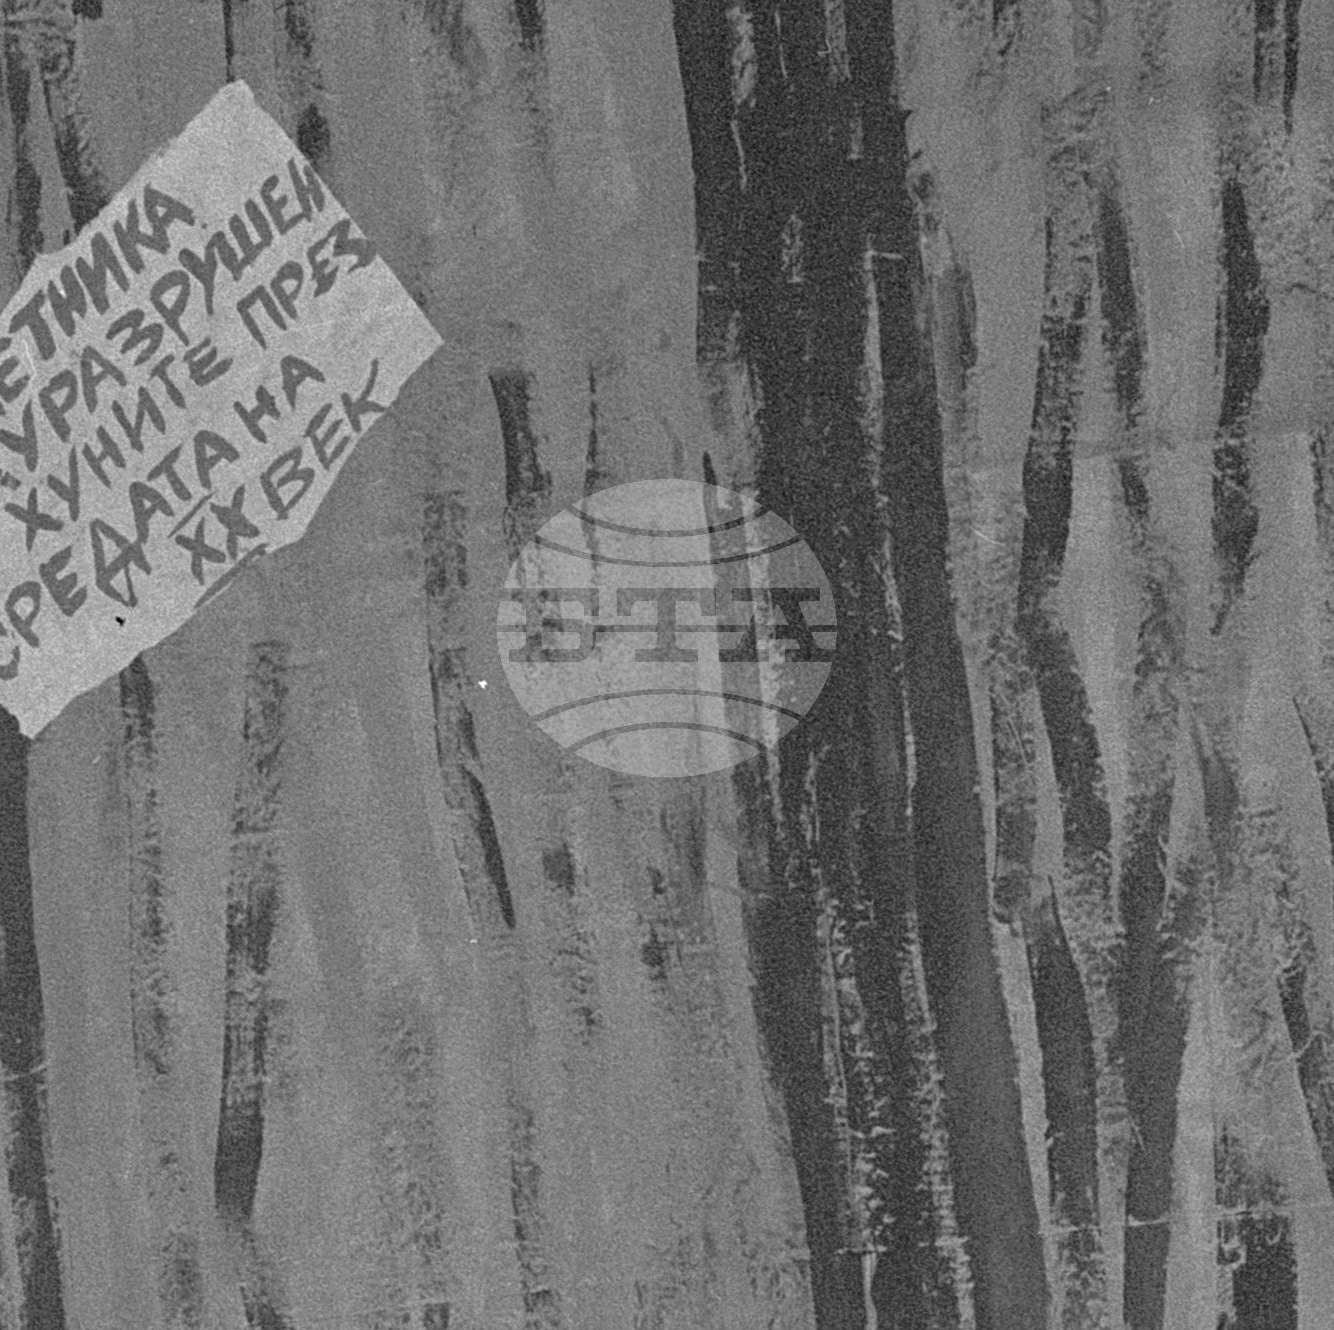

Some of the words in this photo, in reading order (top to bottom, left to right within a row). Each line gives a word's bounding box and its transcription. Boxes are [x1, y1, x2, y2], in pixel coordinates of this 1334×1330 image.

[4, 336, 234, 553] ХУНИТЕ
[235, 217, 374, 351] ПРЕЗ
[234, 354, 326, 444] НА
[260, 356, 393, 520] ВЕК
